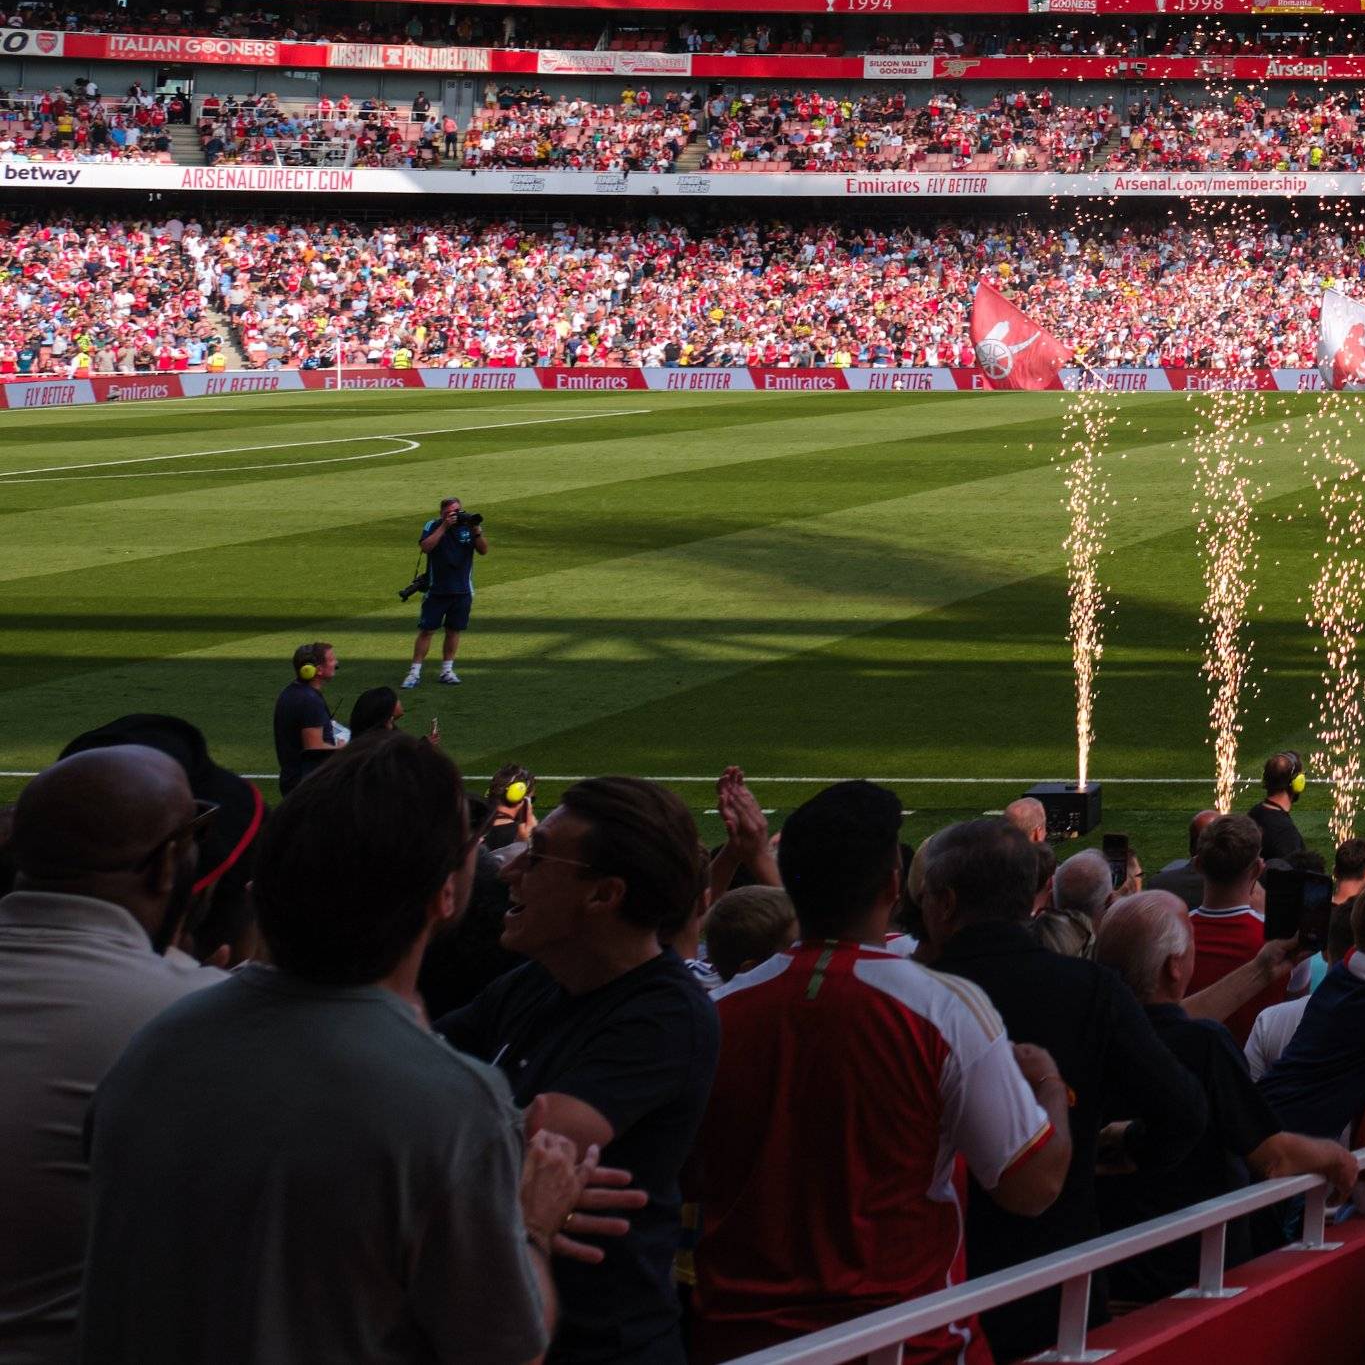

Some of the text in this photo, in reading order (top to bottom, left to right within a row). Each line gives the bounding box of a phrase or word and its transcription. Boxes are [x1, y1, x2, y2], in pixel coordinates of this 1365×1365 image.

[1051, 0, 1096, 9] GOONERS
[109, 35, 276, 57] ITALIAN GOONERS
[330, 45, 489, 70] ARSENAL PHILADELPHIA
[869, 60, 928, 69] SILICON VALLEY
[5, 163, 81, 185] betway
[181, 167, 353, 190] ARSENALDIRECT.COM
[846, 177, 987, 195] Emirates FLY BETTER
[1115, 175, 1307, 195] Arsenal.com/membership
[206, 377, 280, 394] FLY BETTER
[325, 377, 404, 389] Emirates
[448, 373, 516, 389] FLY BETTER
[557, 374, 628, 390] Emirates
[668, 373, 731, 389] FLY BETTER
[765, 374, 836, 390] Emirates
[869, 374, 888, 390] FLY
[1187, 374, 1258, 390] Emirates
[1299, 374, 1319, 390] FLY
[25, 386, 76, 406] FLY BETTER
[108, 384, 169, 401] Emirates
